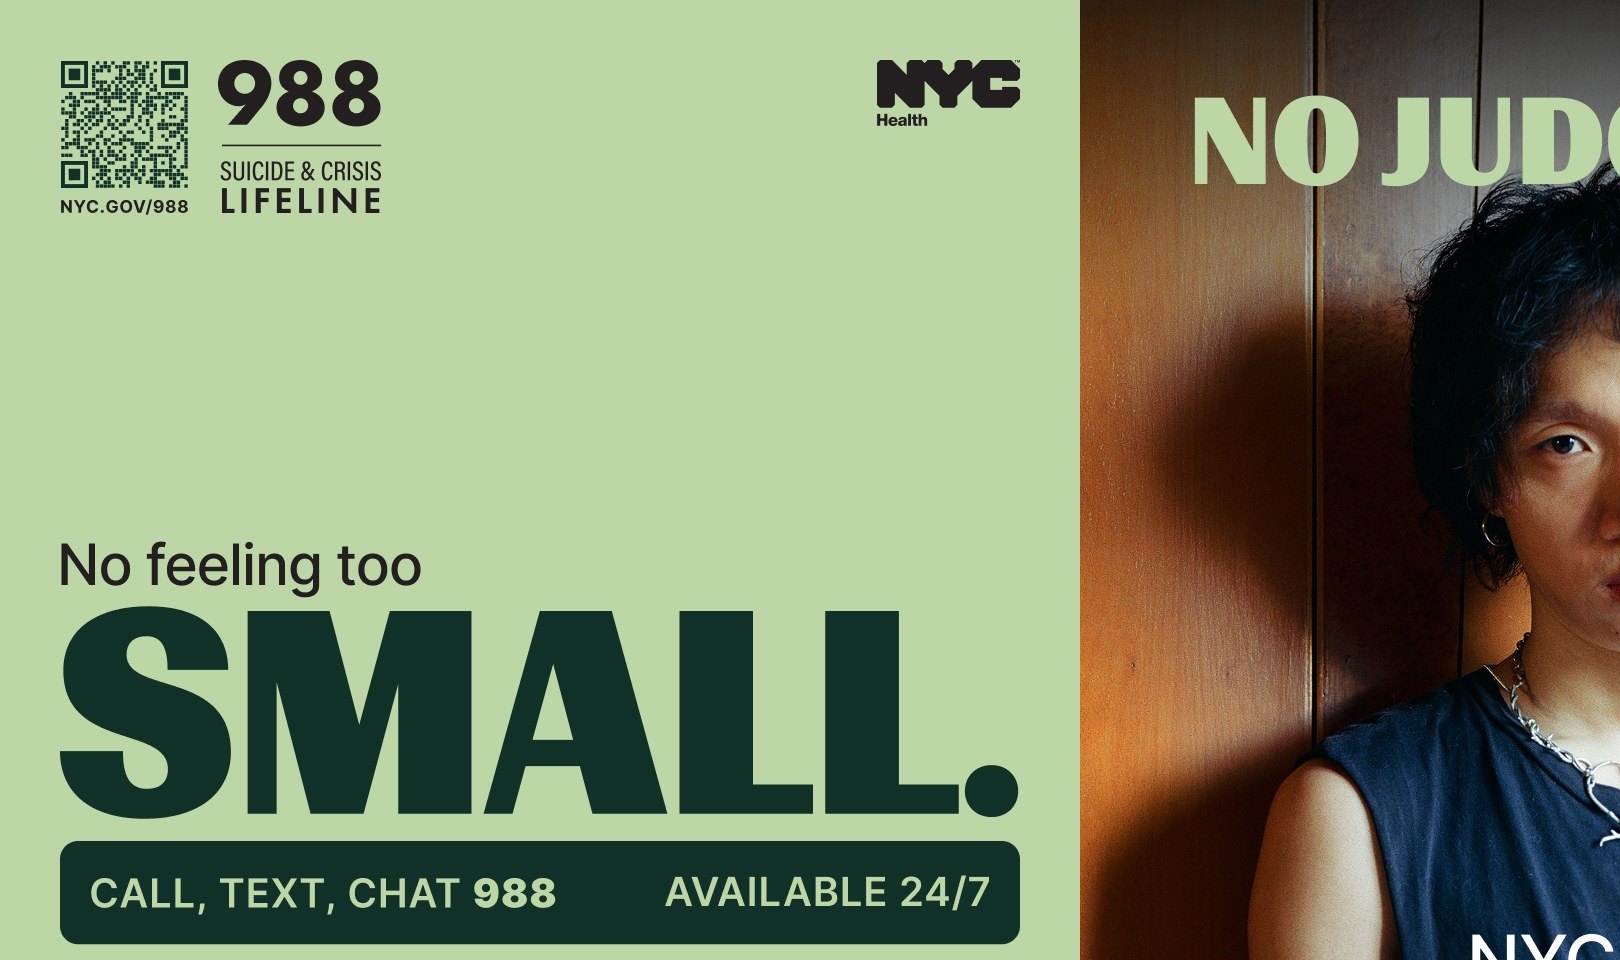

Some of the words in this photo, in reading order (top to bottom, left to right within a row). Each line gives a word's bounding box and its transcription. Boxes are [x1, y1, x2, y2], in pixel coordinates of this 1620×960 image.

[218, 60, 381, 127] 988
[877, 60, 1020, 108] NYC
[877, 114, 928, 126] Health
[1195, 96, 1358, 186] NO
[220, 161, 295, 181] SUICIDE
[301, 161, 316, 181] &
[322, 161, 381, 181] CRISIS
[60, 199, 188, 215] NYC.GOV/988
[222, 188, 380, 213] LIFELINE
[60, 543, 130, 586] No
[147, 541, 319, 597] feeling
[337, 546, 421, 586] too
[60, 606, 1018, 819] SMALL.
[90, 877, 206, 915] CALL,
[220, 877, 334, 915] TEXT,
[349, 877, 460, 908] CHAT
[473, 877, 555, 908] 988
[665, 877, 885, 907] AVAILABLE
[900, 875, 989, 911] 24/7
